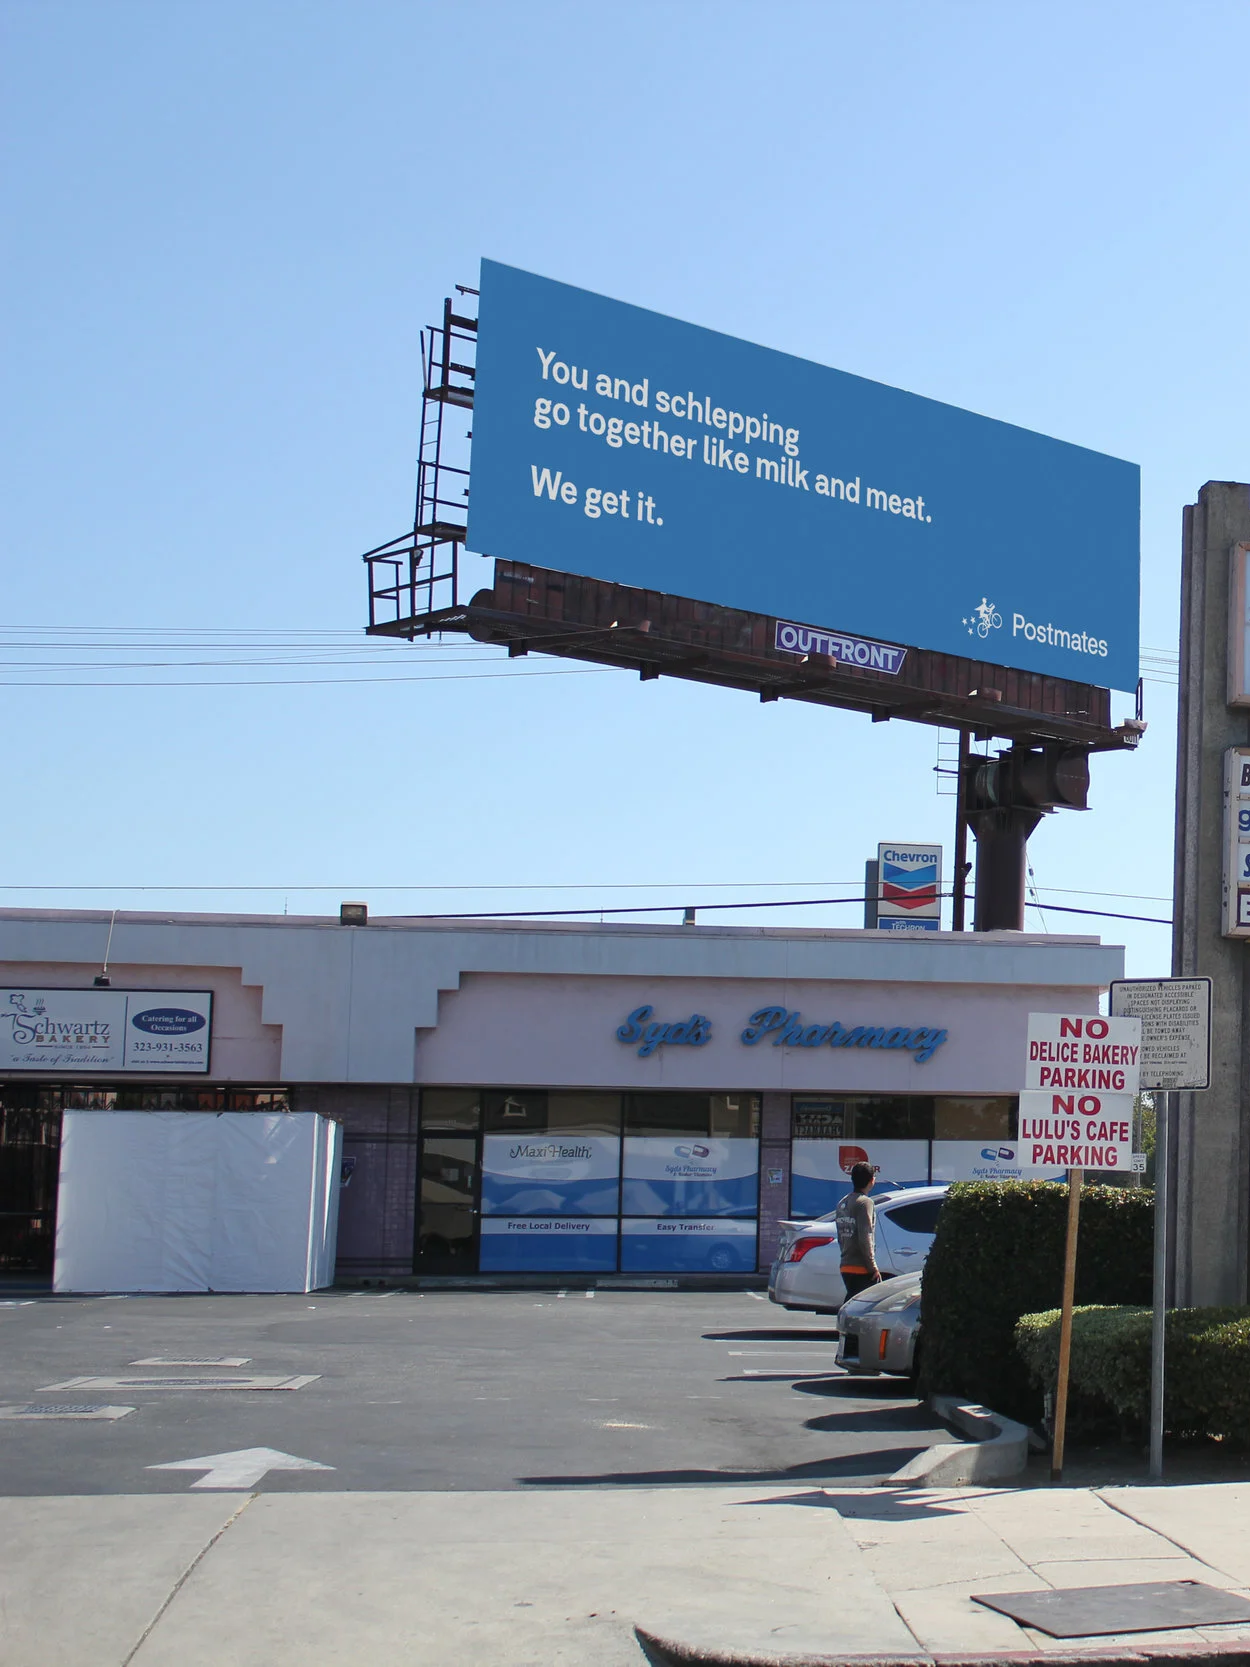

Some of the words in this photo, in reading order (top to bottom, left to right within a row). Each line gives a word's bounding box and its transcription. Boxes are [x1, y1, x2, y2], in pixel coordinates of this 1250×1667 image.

[536, 347, 588, 391] You
[595, 373, 648, 408] and
[655, 386, 800, 455] schlepping
[534, 396, 570, 430] go
[577, 401, 698, 460] together
[703, 438, 749, 474] like
[757, 454, 809, 491] milk
[815, 472, 860, 505] and
[866, 486, 932, 524] meat.
[531, 464, 578, 505] We
[584, 486, 630, 518] get
[637, 491, 664, 526] it.
[1012, 612, 1108, 658] Postmates
[780, 625, 900, 672] OUTFRONT
[884, 850, 937, 863] Chevron
[13, 1013, 110, 1044] Schwartz
[142, 1014, 174, 1025] Catering
[175, 1015, 186, 1023] for
[187, 1014, 197, 1023] all
[151, 1024, 187, 1032] Occasions
[1060, 1018, 1110, 1040] NO
[35, 1035, 110, 1043] BAKERY
[741, 1006, 948, 1063] Pharmacy
[1030, 1041, 1079, 1064] DELICE
[1083, 1043, 1139, 1066] BAKERY
[1040, 1067, 1125, 1090] PARKING
[1052, 1094, 1101, 1116] NO
[1022, 1119, 1080, 1141] LULU'S
[1086, 1121, 1129, 1142] CAFE
[1032, 1144, 1118, 1167] PARKING
[1133, 1163, 1145, 1171] 35
[992, 1167, 1022, 1177] Pharmacy
[508, 1222, 527, 1230] Free
[530, 1222, 552, 1230] Local
[554, 1222, 590, 1232] Delivery
[657, 1223, 676, 1232] Easy
